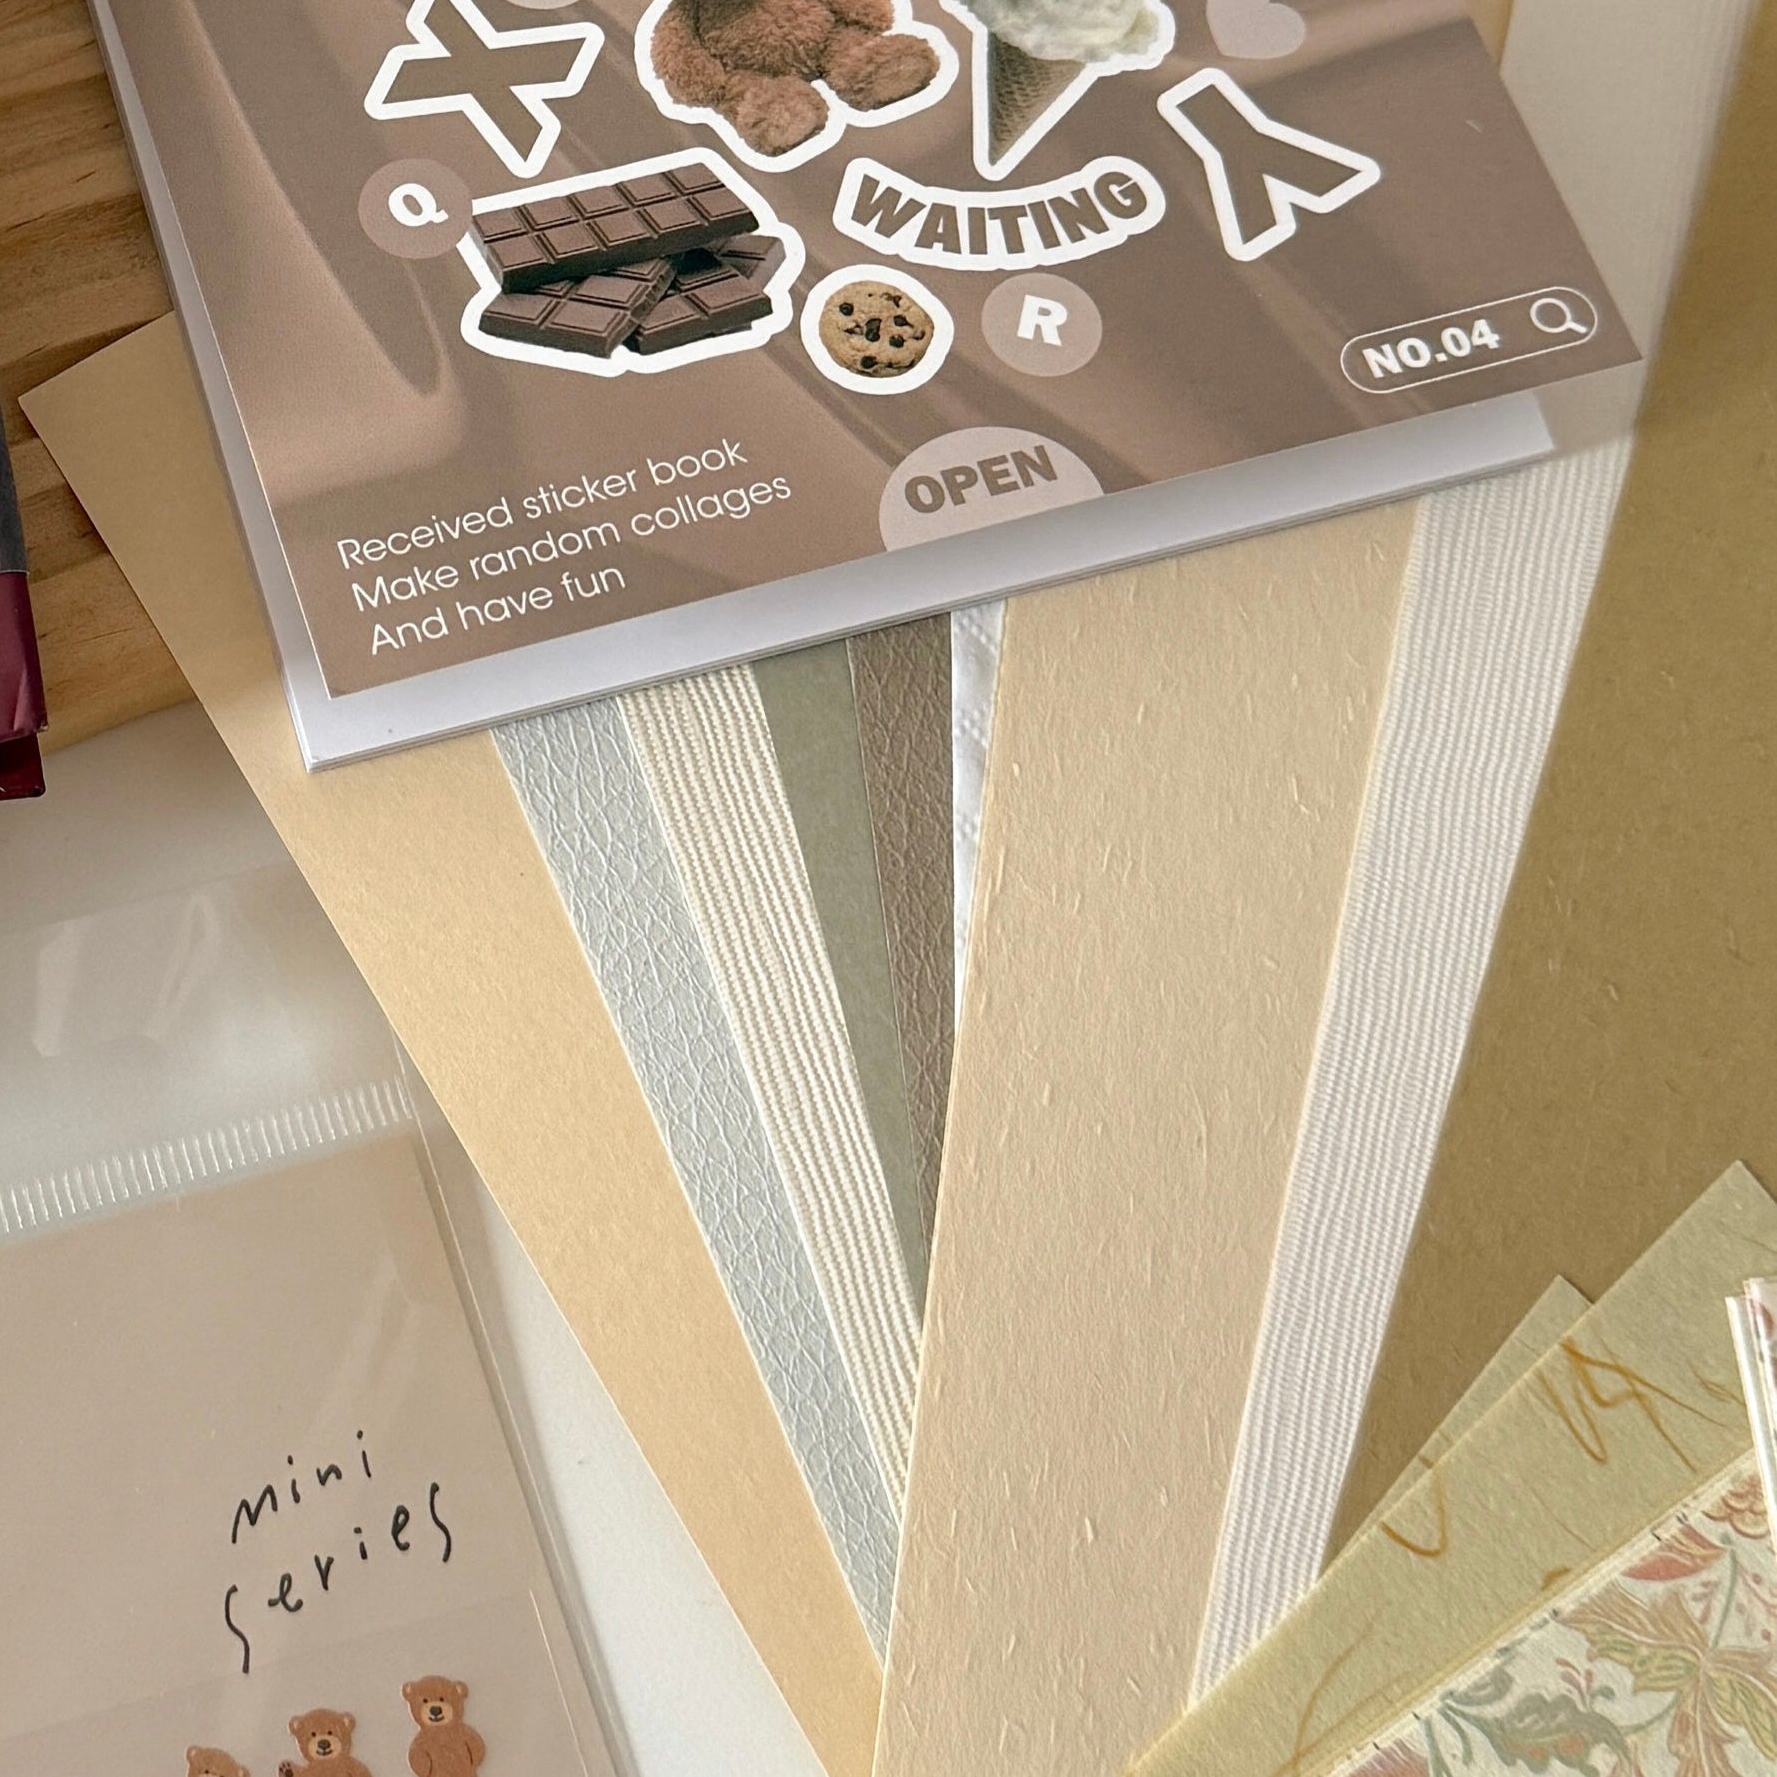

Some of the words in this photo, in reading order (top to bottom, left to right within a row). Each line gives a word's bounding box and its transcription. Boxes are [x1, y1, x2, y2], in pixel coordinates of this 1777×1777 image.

[387, 182, 449, 229] Q
[847, 167, 1151, 258] WAITING
[1014, 292, 1070, 347] R
[1362, 319, 1501, 378] NO.04
[336, 496, 515, 570] Received
[522, 468, 638, 520] sticker
[647, 437, 749, 486] book
[903, 445, 1061, 515] OPEN
[351, 560, 460, 613] Make
[469, 520, 622, 581] random
[630, 474, 792, 538] collages
[370, 613, 450, 656] And
[456, 583, 554, 632] have
[560, 566, 627, 602] fun
[230, 1430, 375, 1545] mini
[224, 1482, 453, 1676] series
